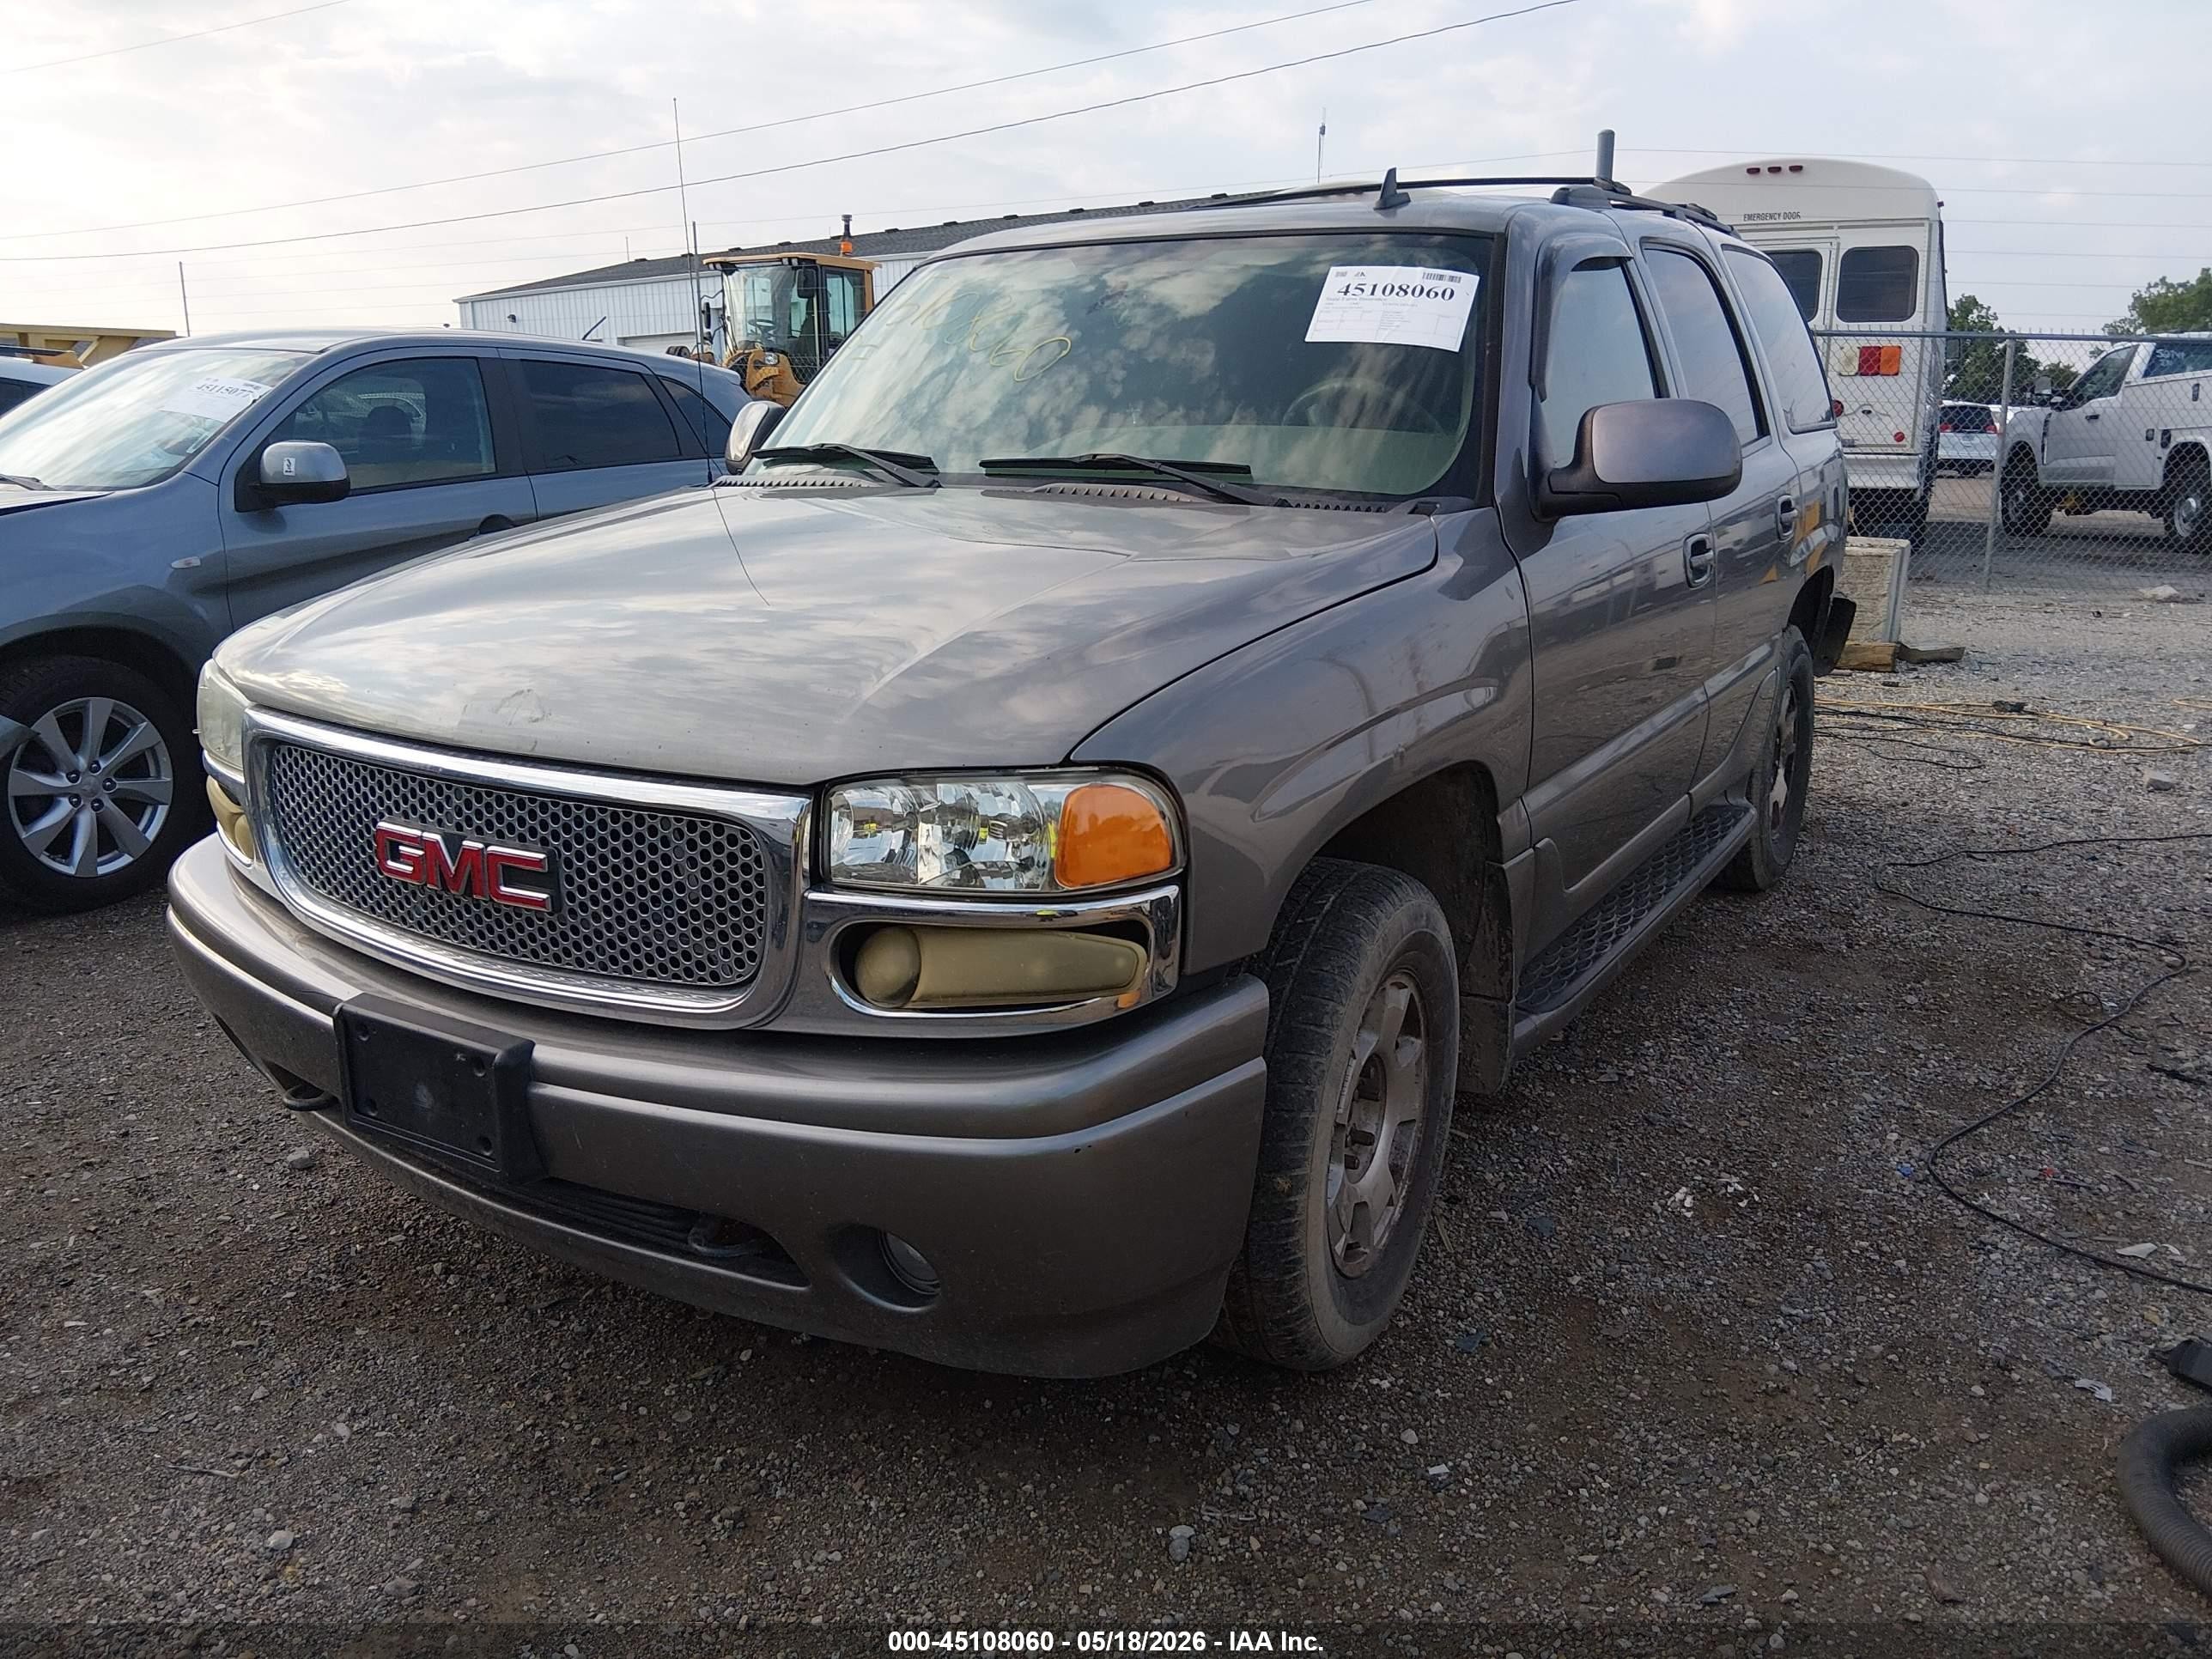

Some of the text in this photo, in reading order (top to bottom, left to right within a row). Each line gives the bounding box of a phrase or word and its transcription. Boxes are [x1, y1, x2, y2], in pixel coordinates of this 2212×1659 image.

[1743, 212, 1782, 222] EMERGENCY
[1337, 283, 1455, 301] 45108060
[375, 821, 552, 912] GMC
